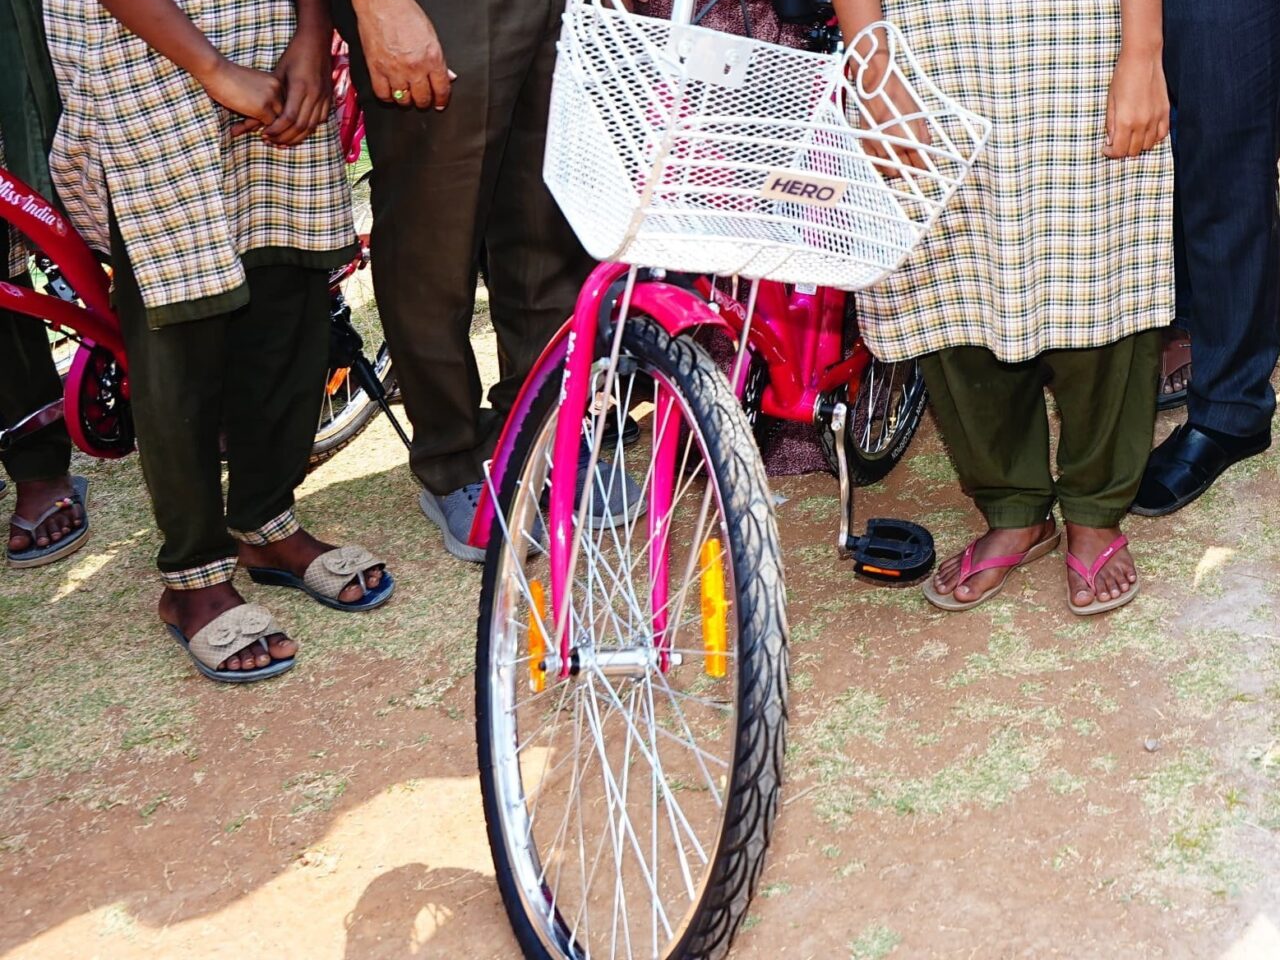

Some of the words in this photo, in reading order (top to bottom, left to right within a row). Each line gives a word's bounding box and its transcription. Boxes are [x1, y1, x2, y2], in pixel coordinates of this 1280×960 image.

[0, 175, 23, 205] Miss
[21, 194, 57, 226] India
[770, 177, 835, 201] HERO
